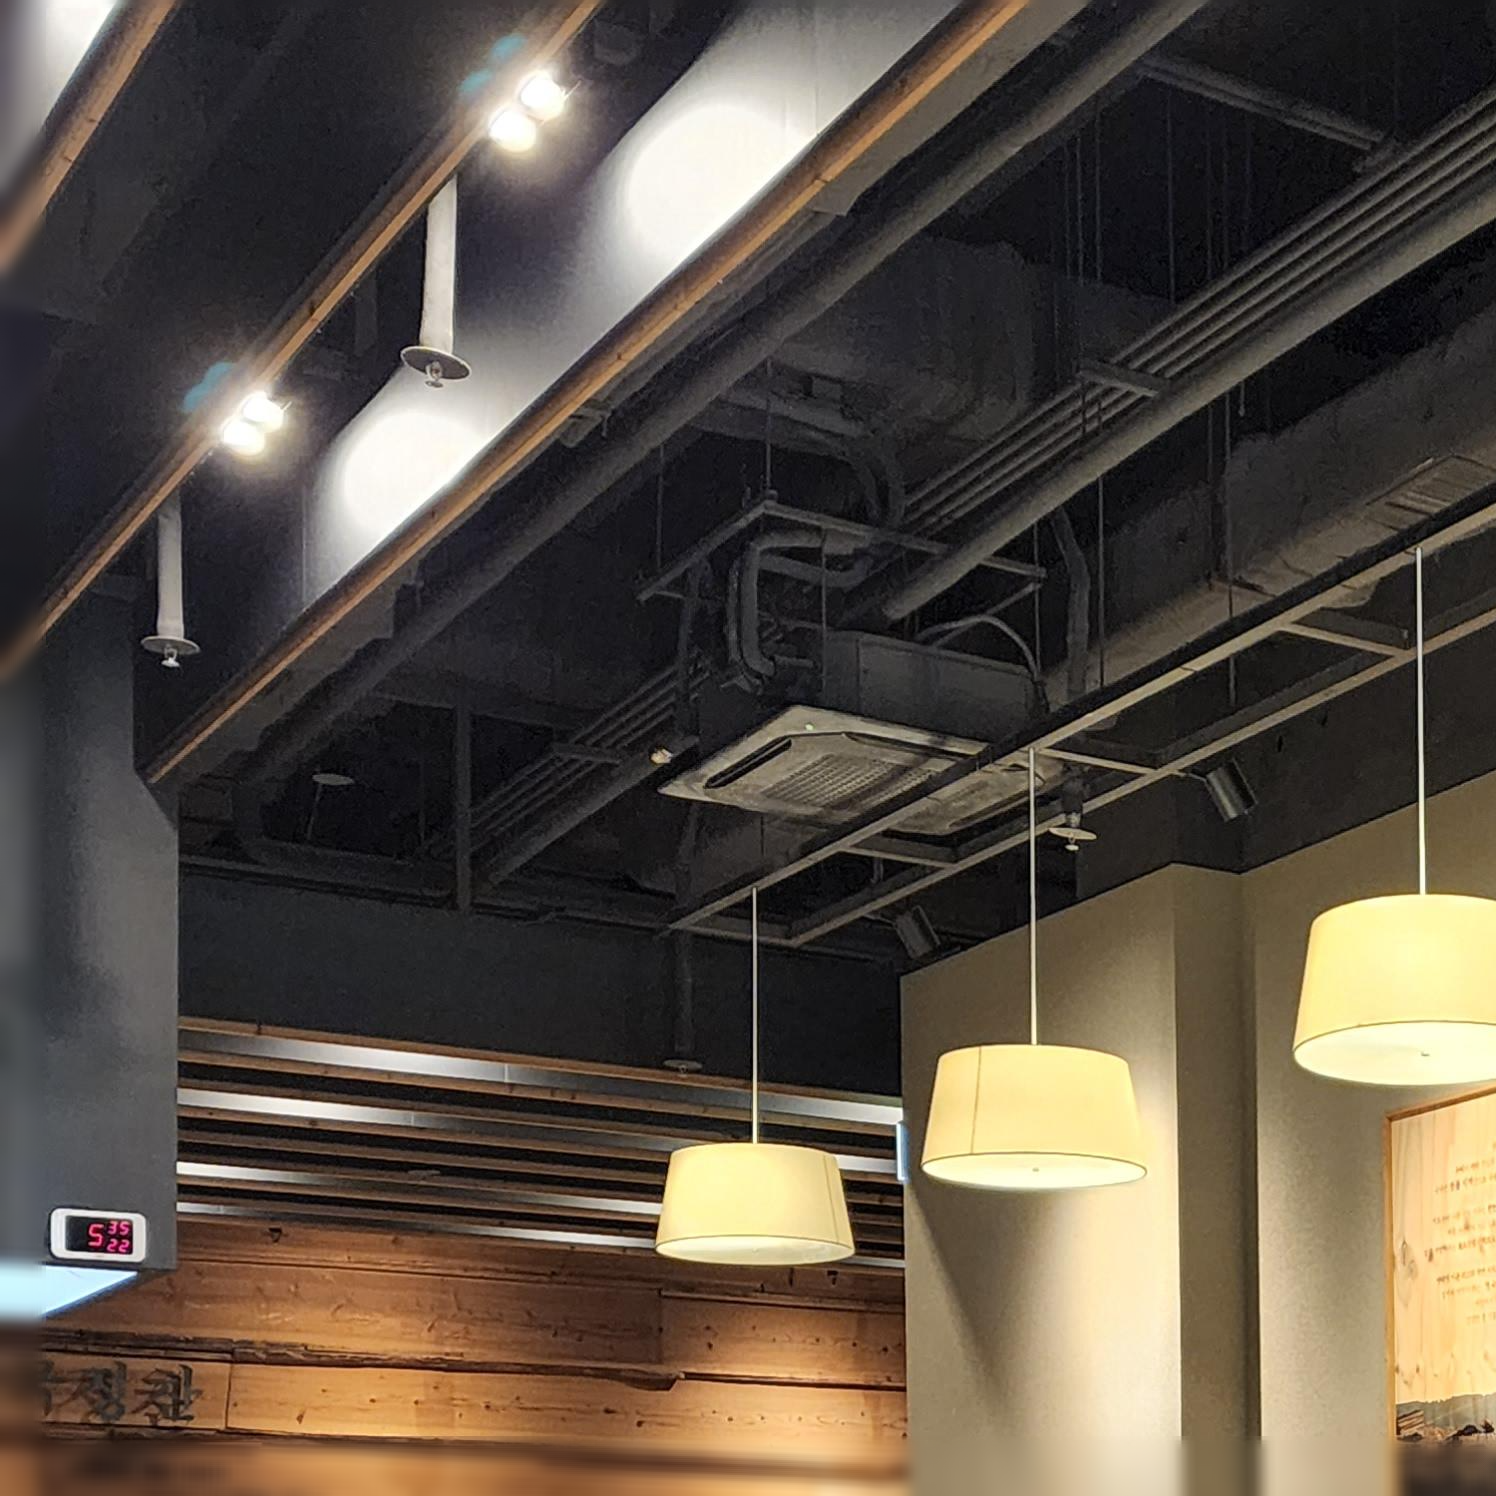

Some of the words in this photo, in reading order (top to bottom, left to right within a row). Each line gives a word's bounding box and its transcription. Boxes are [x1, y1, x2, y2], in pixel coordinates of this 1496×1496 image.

[88, 1223, 104, 1247] 5
[107, 1220, 130, 1236] 35
[106, 1239, 130, 1253] 22
